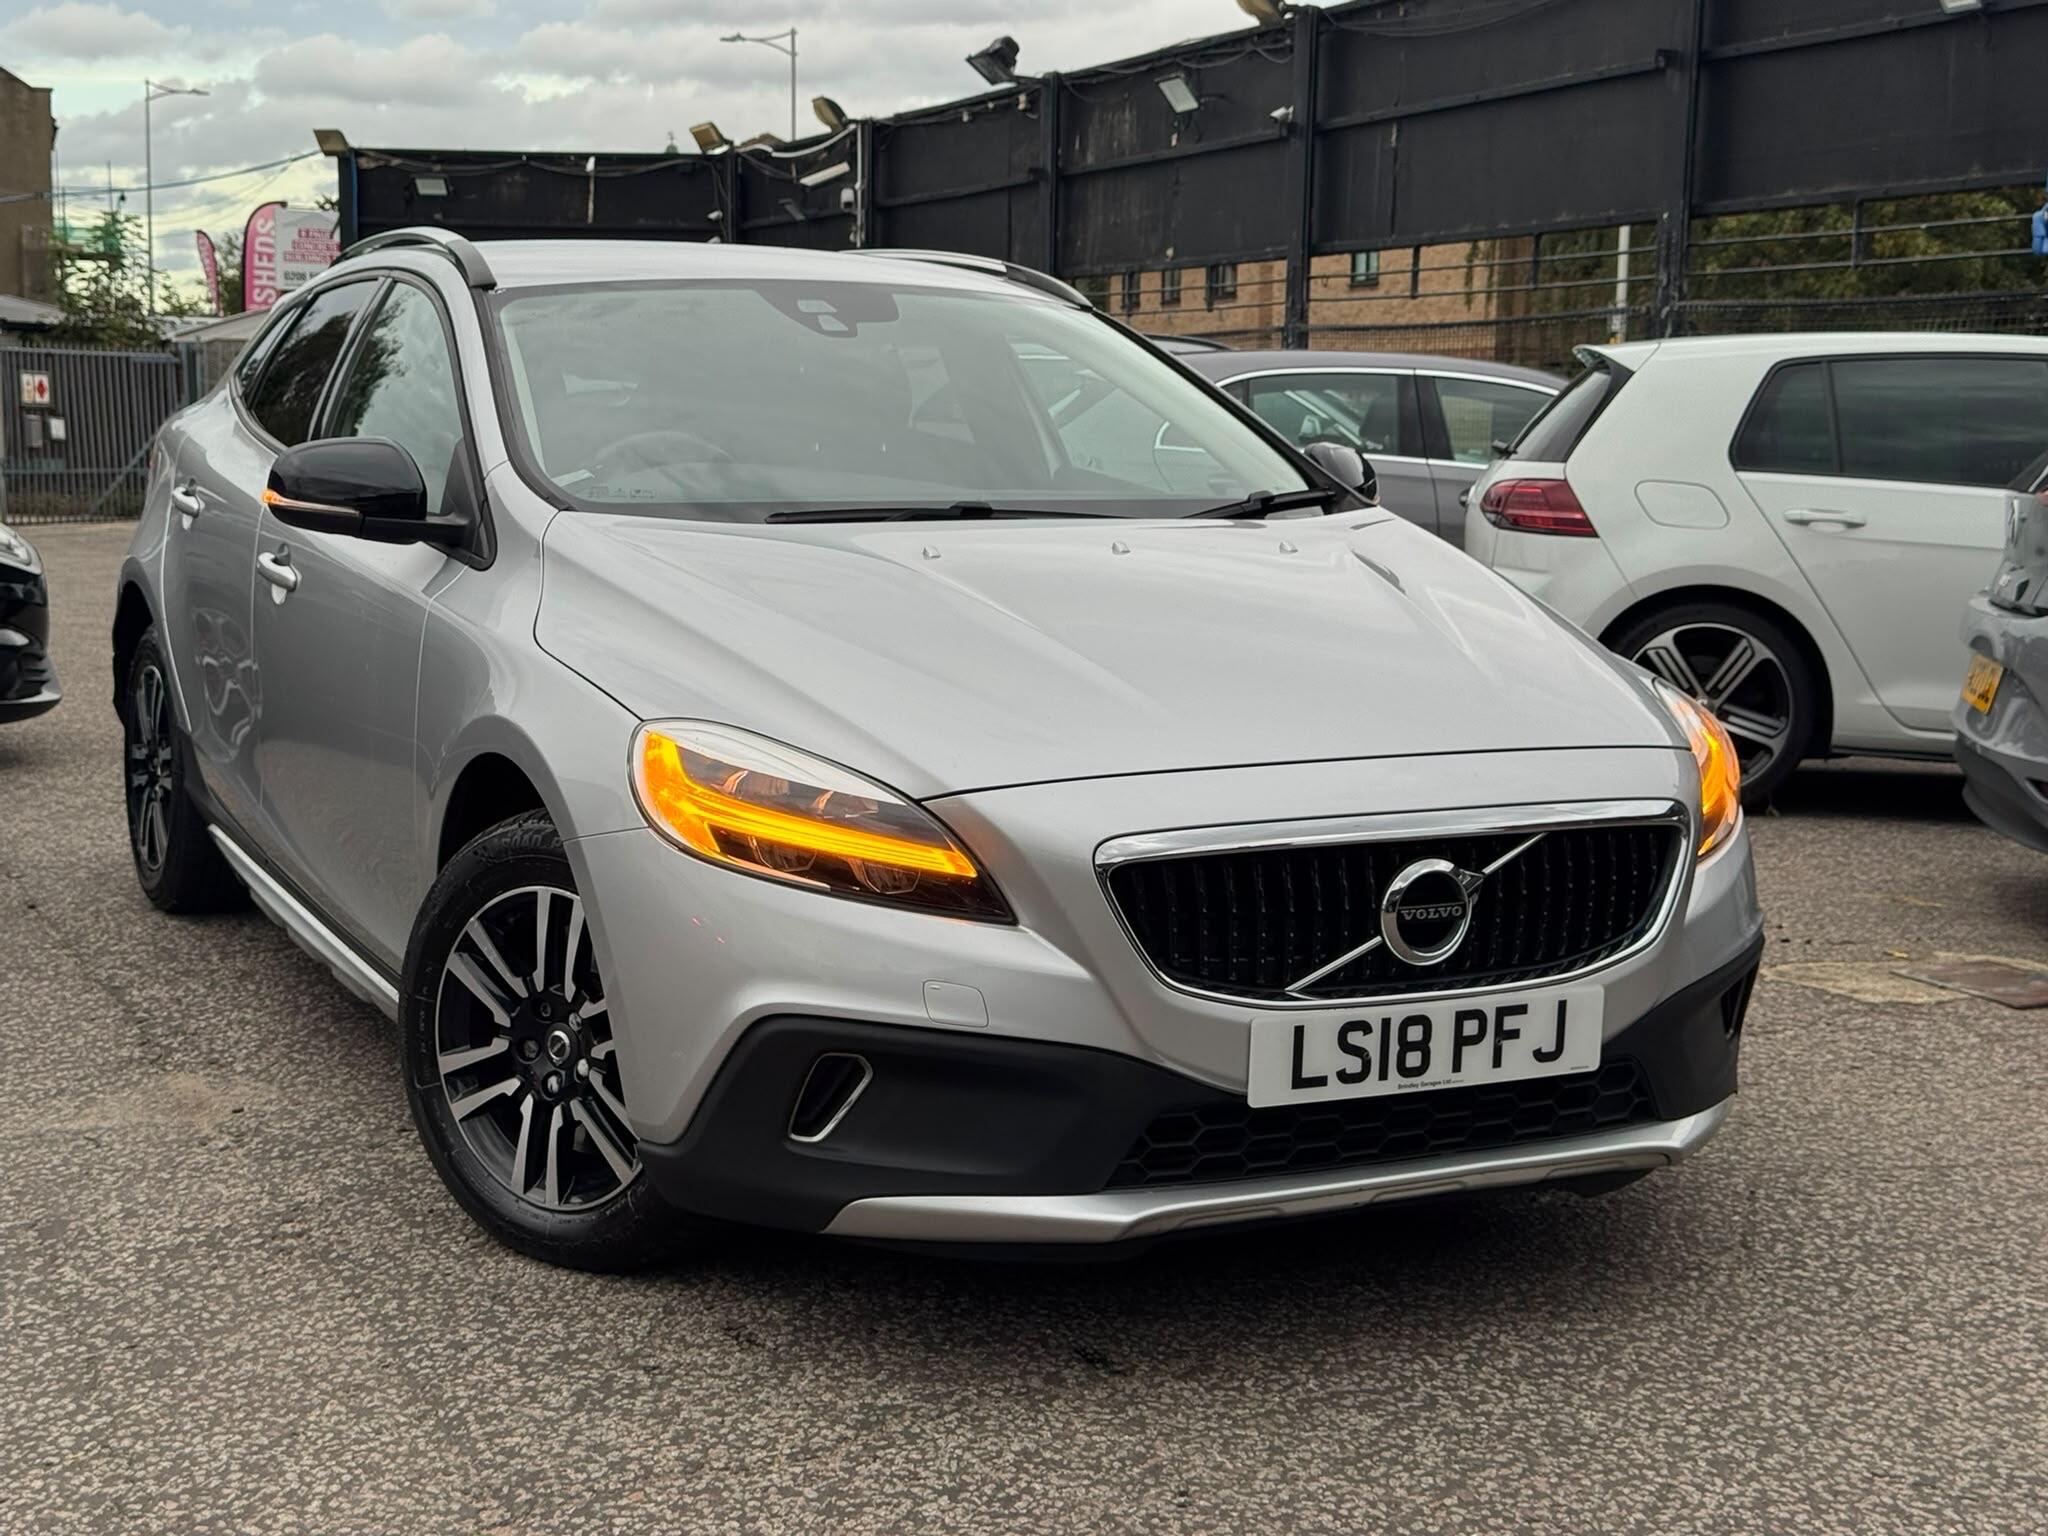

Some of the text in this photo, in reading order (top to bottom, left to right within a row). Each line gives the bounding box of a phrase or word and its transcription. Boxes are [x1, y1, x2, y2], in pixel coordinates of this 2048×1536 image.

[1401, 905, 1463, 921] VOLVO
[1291, 999, 1568, 1090] LS18 PFJ
